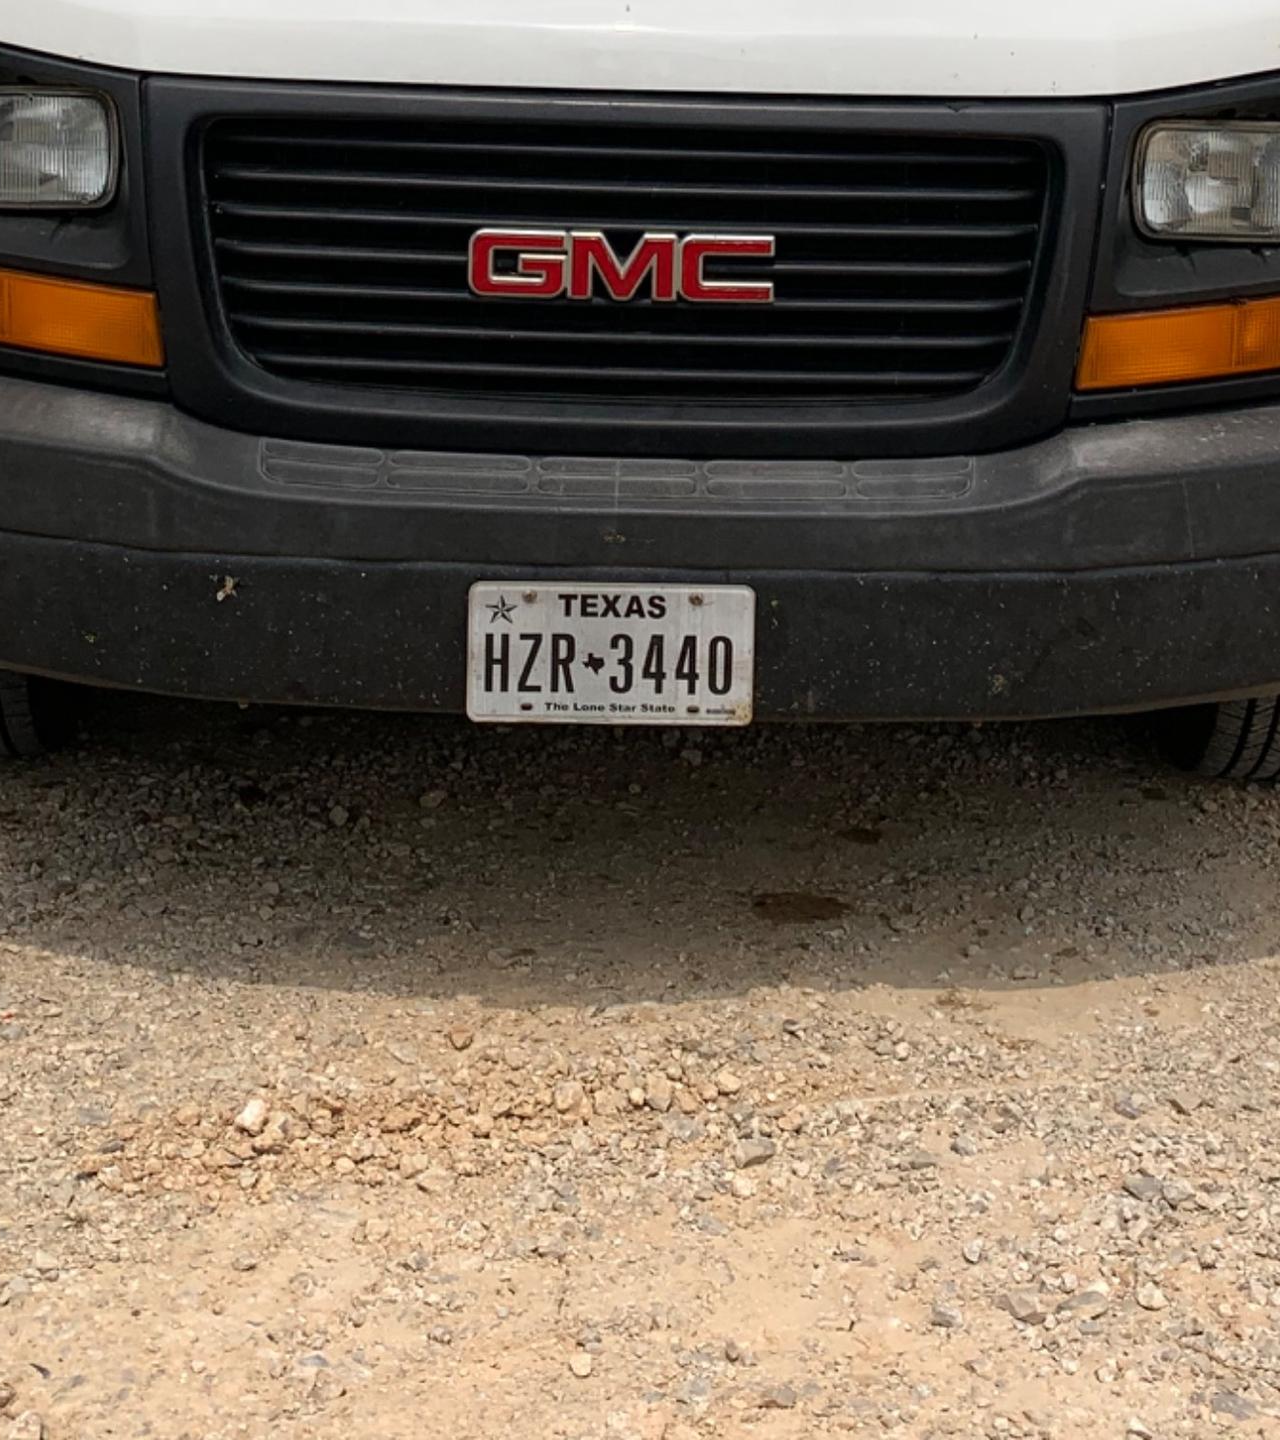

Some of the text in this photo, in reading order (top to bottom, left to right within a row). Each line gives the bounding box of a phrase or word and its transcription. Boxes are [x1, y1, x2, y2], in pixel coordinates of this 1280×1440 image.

[468, 228, 776, 303] GMC
[558, 593, 667, 619] TEXAS
[545, 702, 676, 713] The Lone Star State
